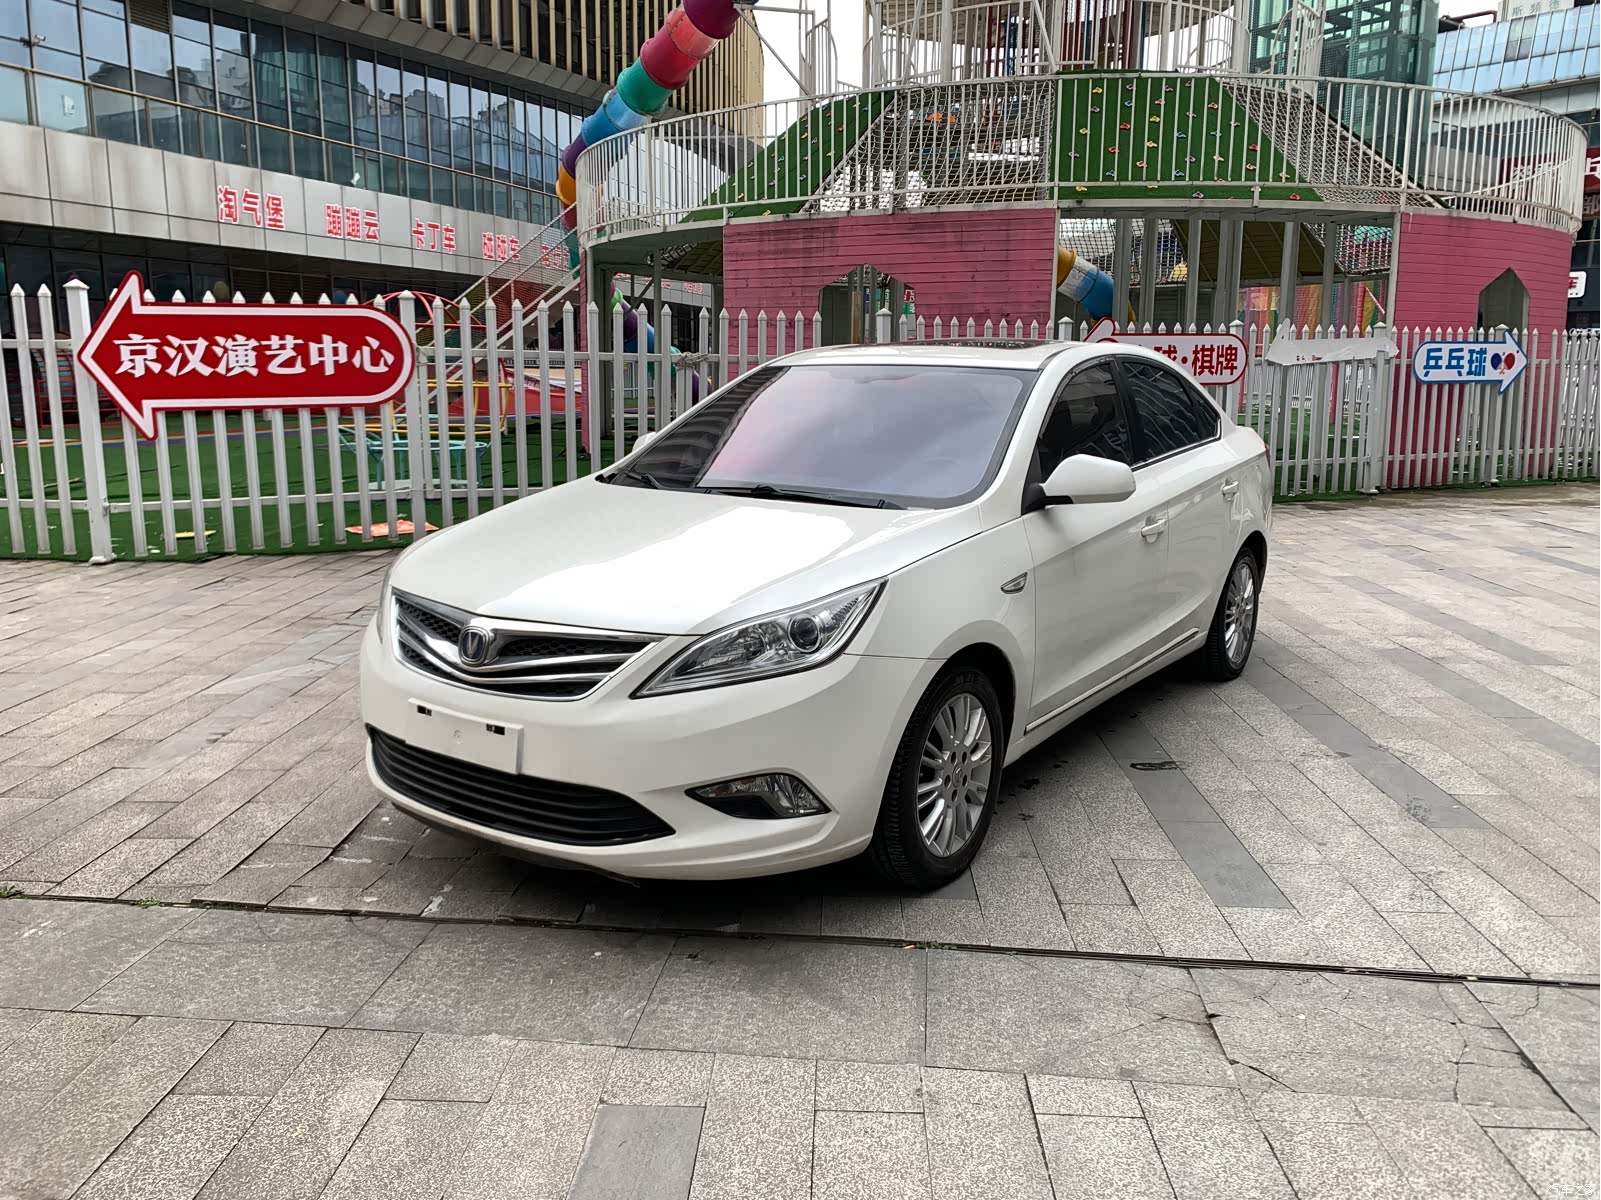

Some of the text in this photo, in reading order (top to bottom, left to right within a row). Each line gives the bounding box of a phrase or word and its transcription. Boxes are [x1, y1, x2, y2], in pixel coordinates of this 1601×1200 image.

[217, 185, 285, 230] 淘气堡
[325, 203, 379, 242] 蹦蹦云
[411, 217, 457, 254] 卡丁车
[482, 231, 520, 264] 碰碰车
[112, 333, 396, 378] 京汉演艺中心
[1423, 347, 1487, 377] 乒乓球
